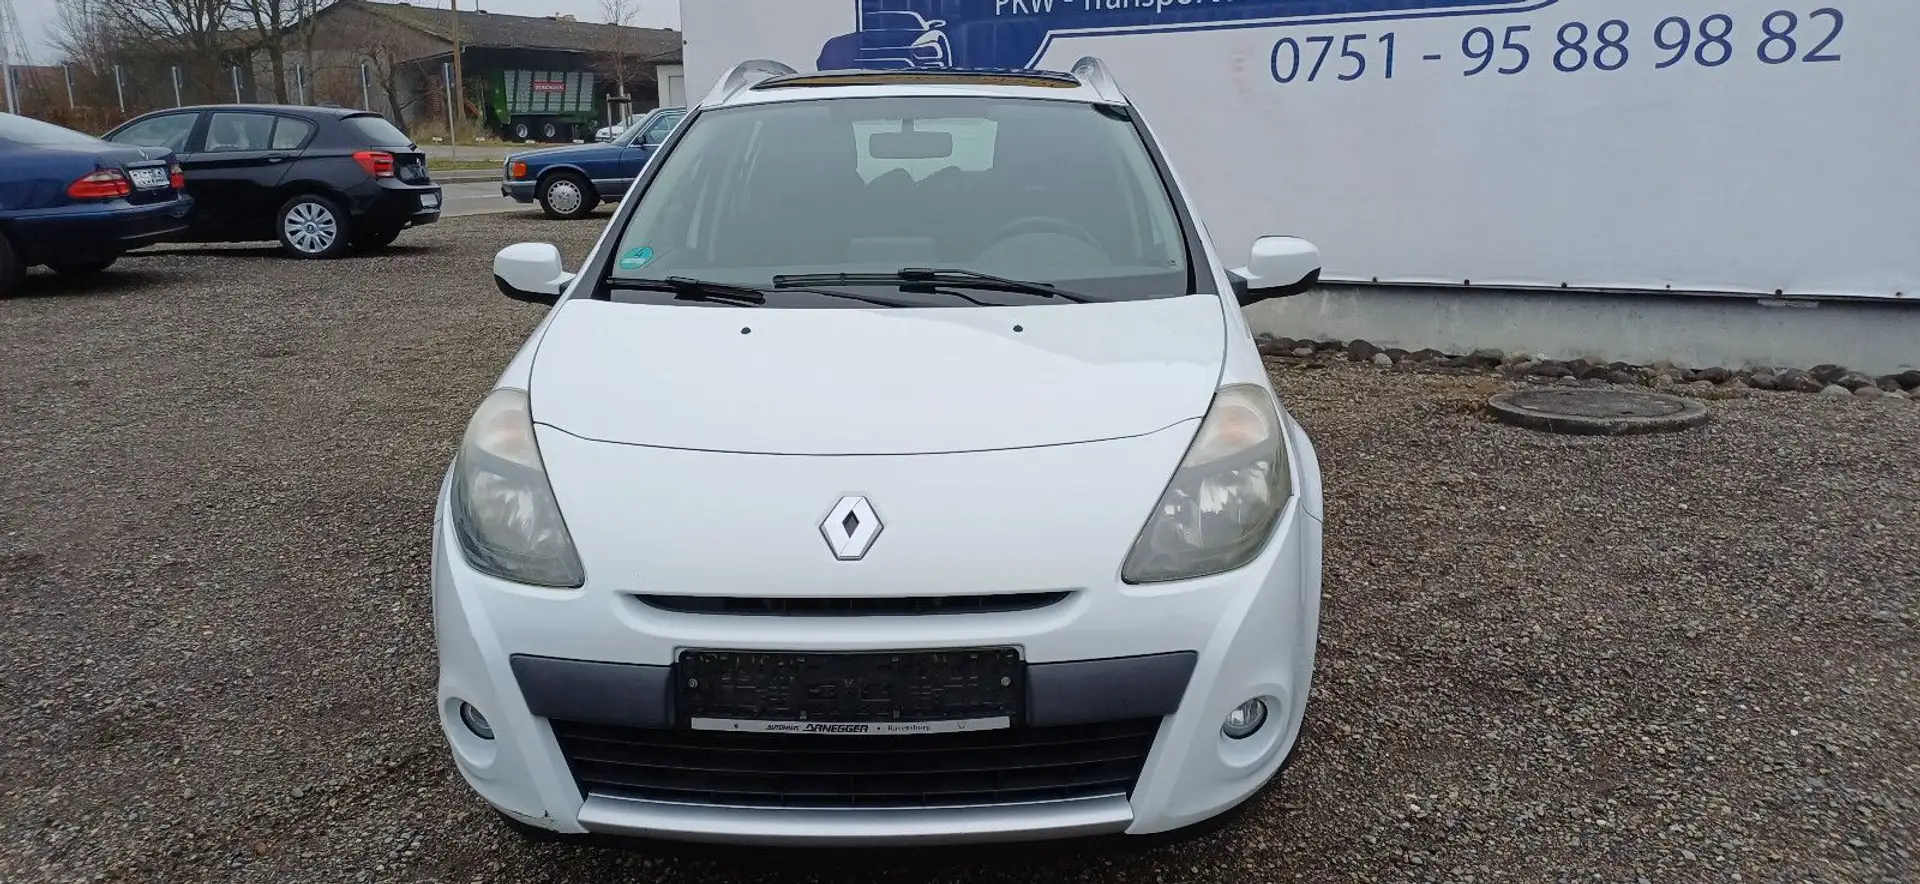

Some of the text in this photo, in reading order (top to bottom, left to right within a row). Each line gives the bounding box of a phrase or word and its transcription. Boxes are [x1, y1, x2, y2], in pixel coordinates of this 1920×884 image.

[1270, 32, 1396, 84] 0751
[1461, 25, 1531, 77] 95
[1552, 19, 1630, 73] 88
[1653, 14, 1734, 69] 98
[1756, 7, 1845, 65] 82
[633, 247, 646, 257] 4
[803, 723, 869, 733] ARNEGGER
[887, 724, 931, 733] Ravensburg
